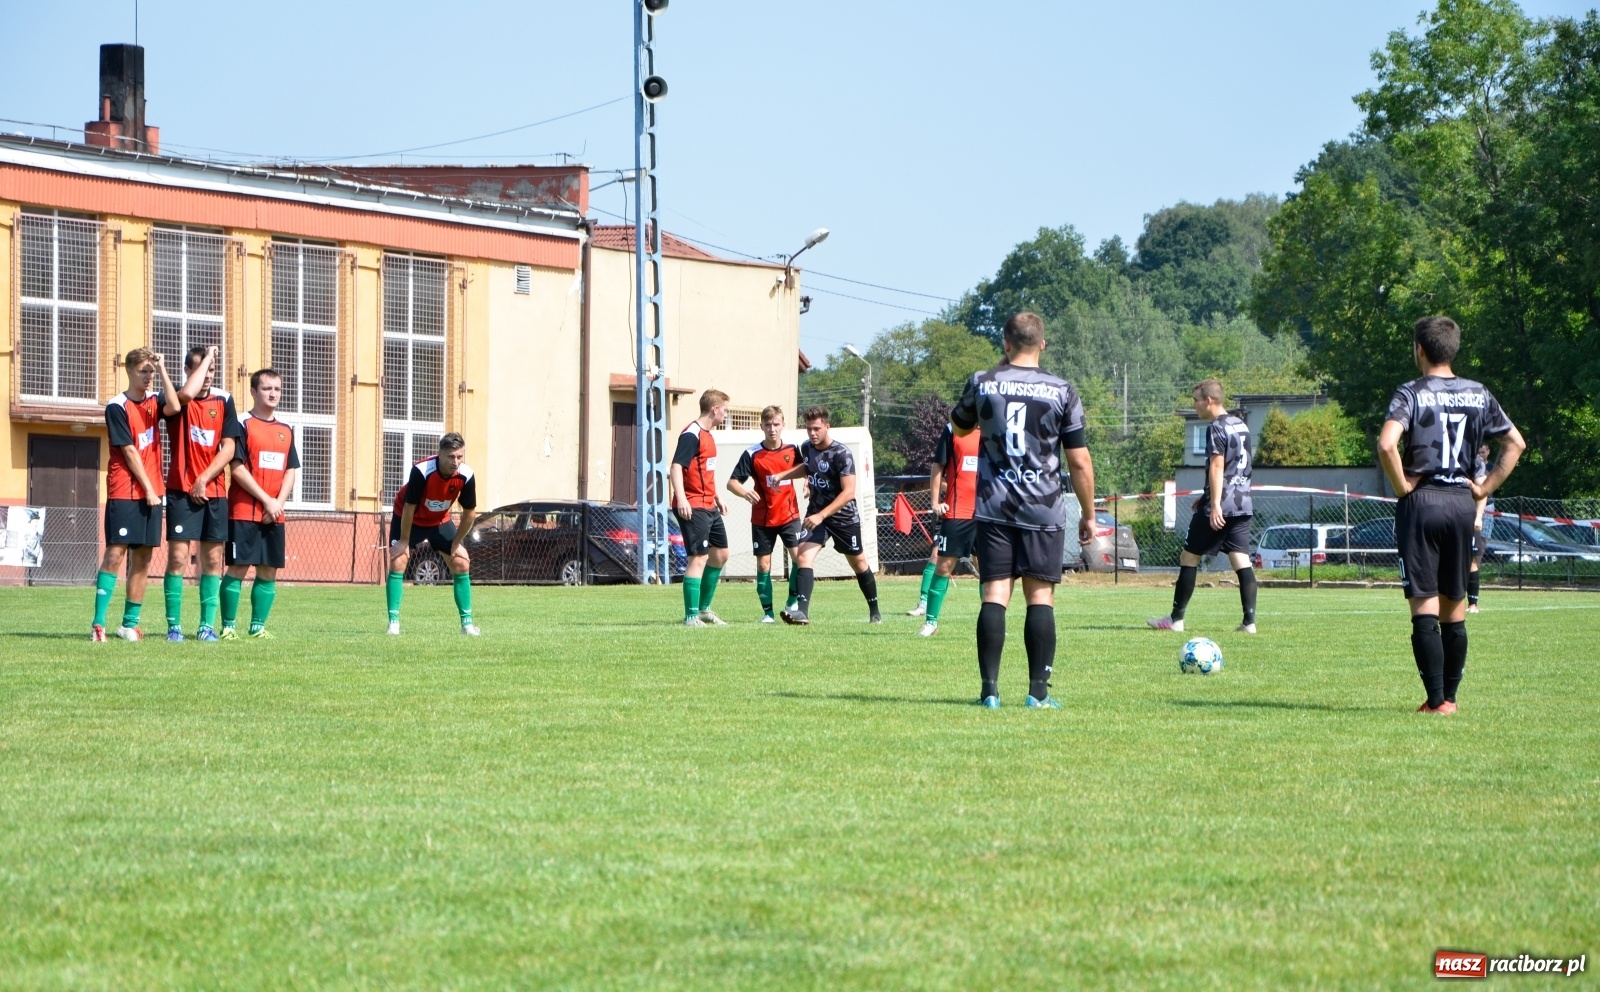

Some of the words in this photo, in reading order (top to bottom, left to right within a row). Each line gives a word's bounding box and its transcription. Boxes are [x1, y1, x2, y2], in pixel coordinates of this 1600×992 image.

[999, 381, 1060, 401] OWSISZCZE
[1006, 402, 1027, 456] 8
[1440, 412, 1468, 469] 17
[851, 535, 857, 547] 9
